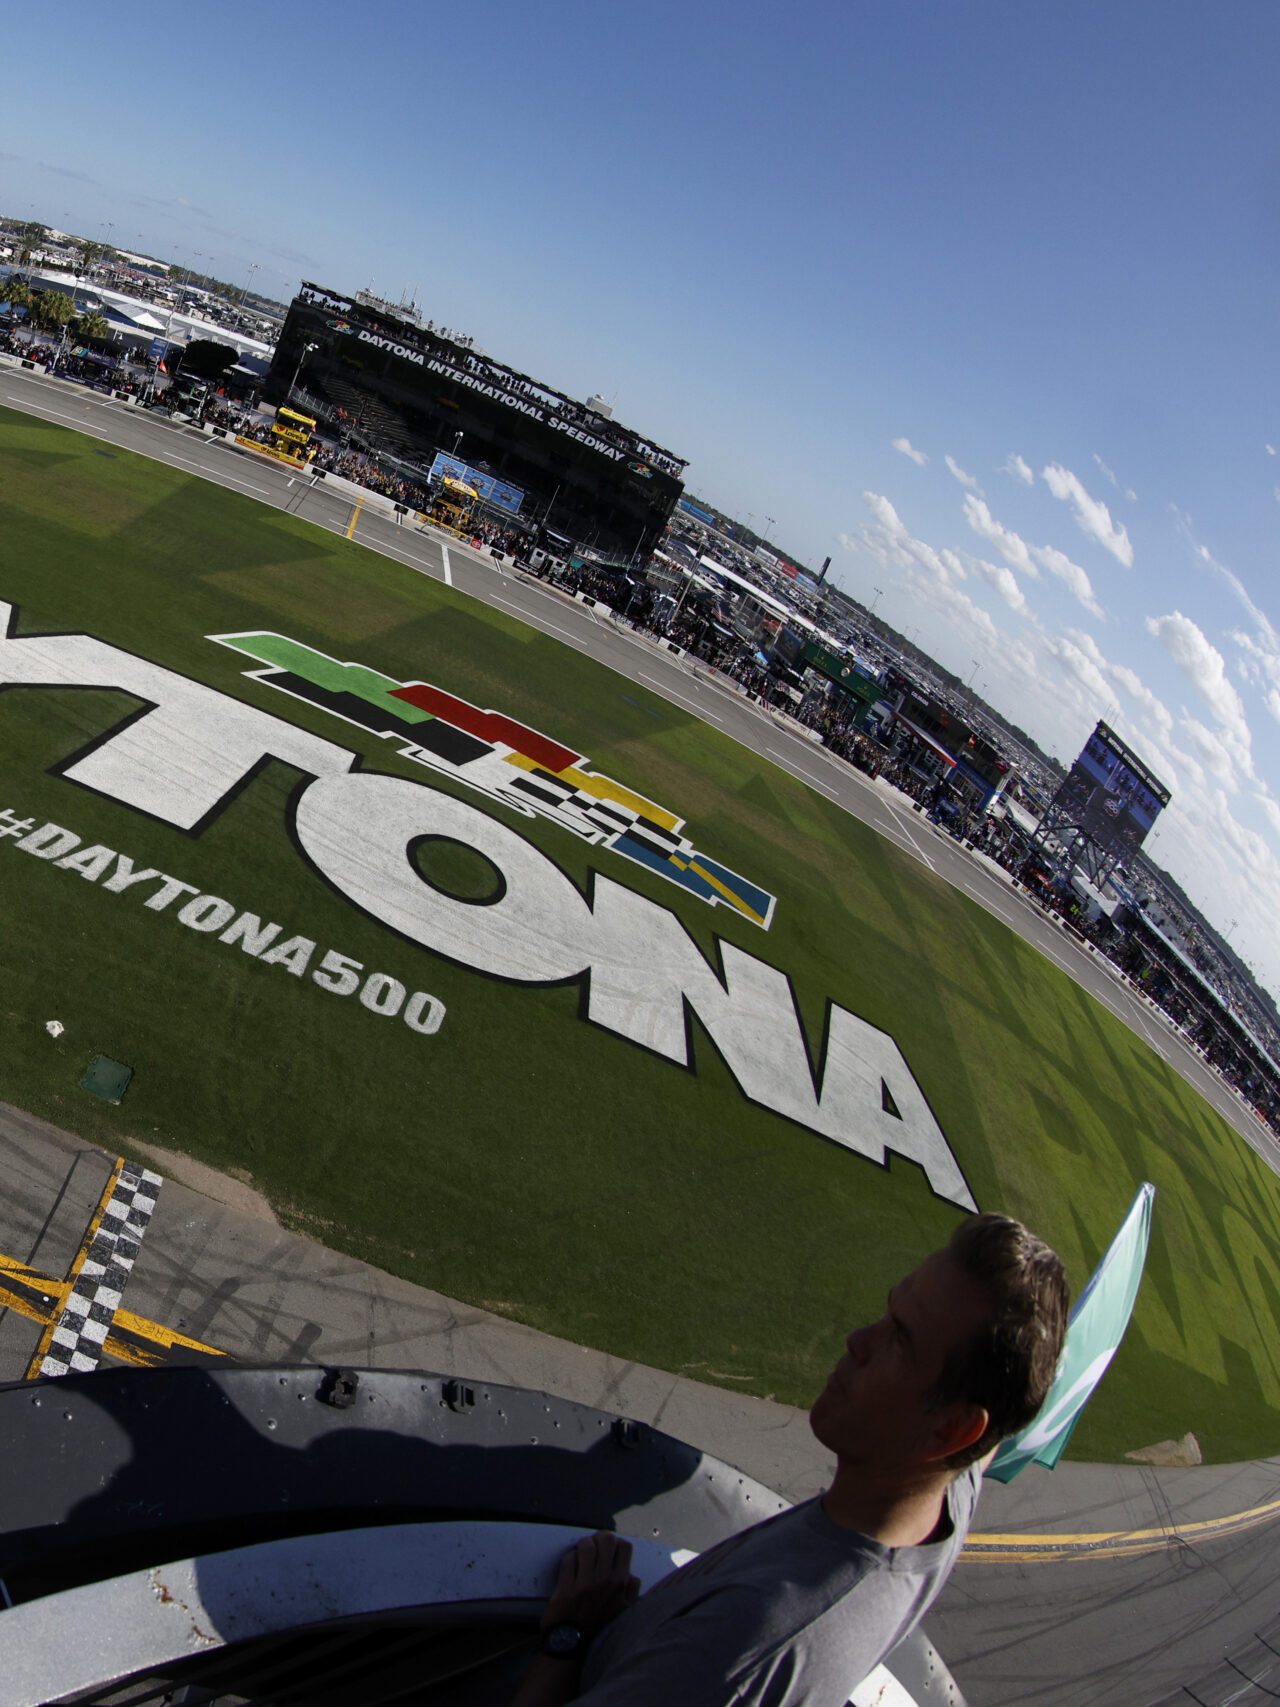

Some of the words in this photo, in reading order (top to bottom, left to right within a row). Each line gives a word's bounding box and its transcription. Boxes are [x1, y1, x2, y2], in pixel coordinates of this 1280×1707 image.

[357, 329, 425, 366] DAYTONA
[426, 359, 545, 422] INTERNATIONAL
[547, 416, 627, 463] SPEEDWAY
